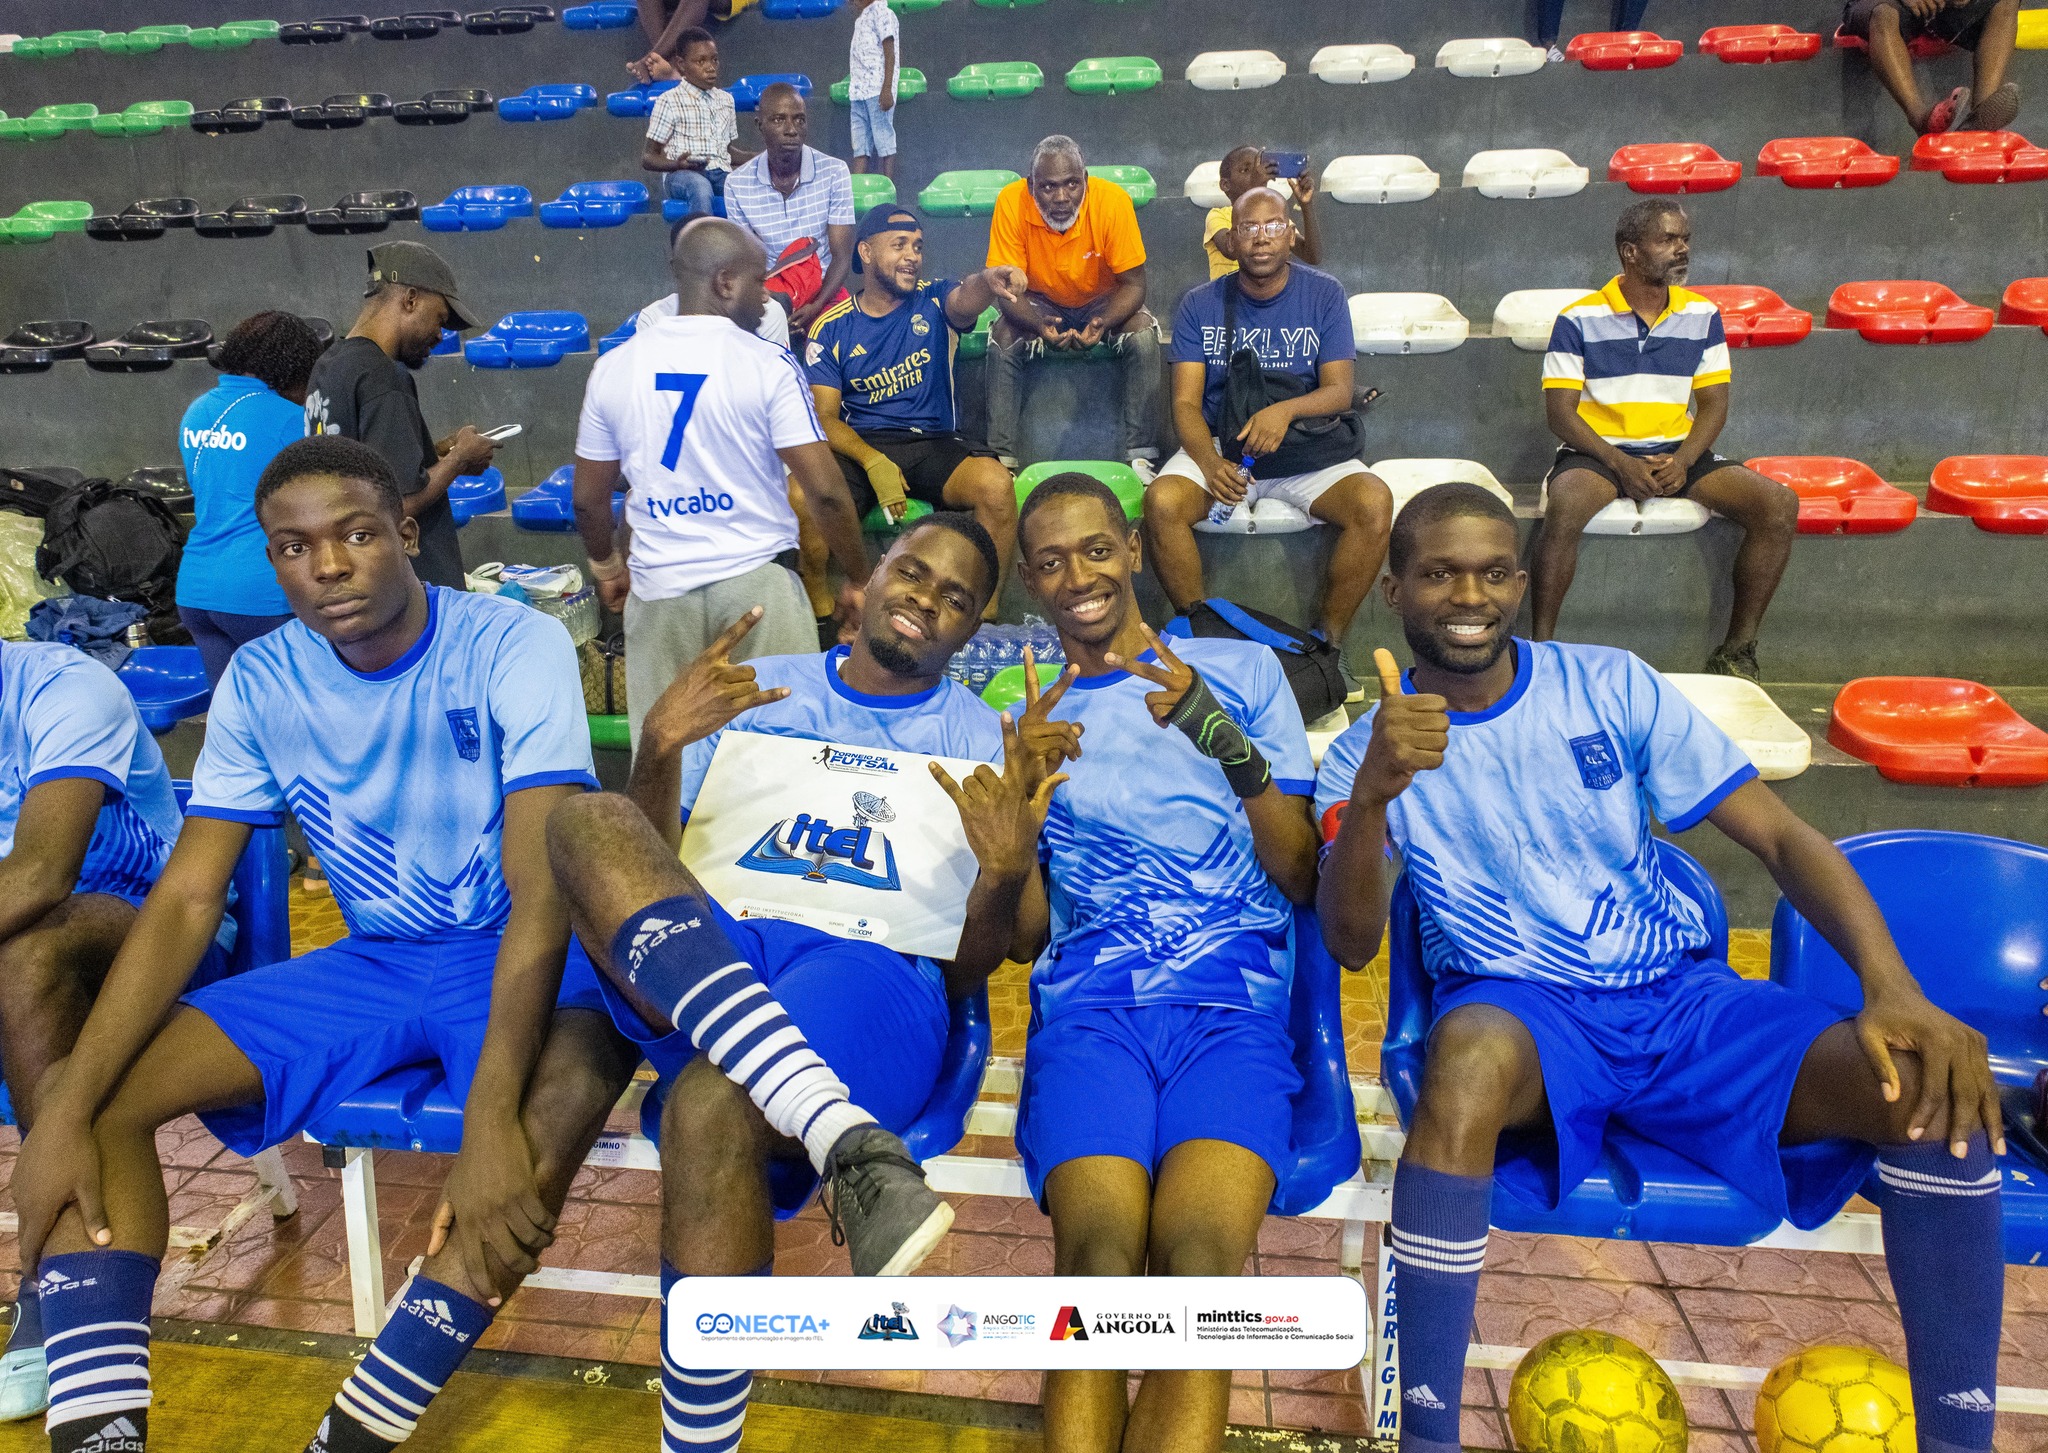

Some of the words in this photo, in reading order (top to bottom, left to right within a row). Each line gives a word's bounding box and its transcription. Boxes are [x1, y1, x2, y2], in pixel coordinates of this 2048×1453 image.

[655, 373, 709, 473] 7
[183, 424, 247, 451] tvcabo
[647, 487, 734, 519] tvcabo
[830, 755, 899, 771] FUTSAL
[833, 750, 873, 760] TORNEIO
[628, 916, 702, 984] adidas
[592, 1141, 620, 1149] GIMNO
[400, 1299, 470, 1343] adidas
[1403, 1391, 1446, 1410] adidas
